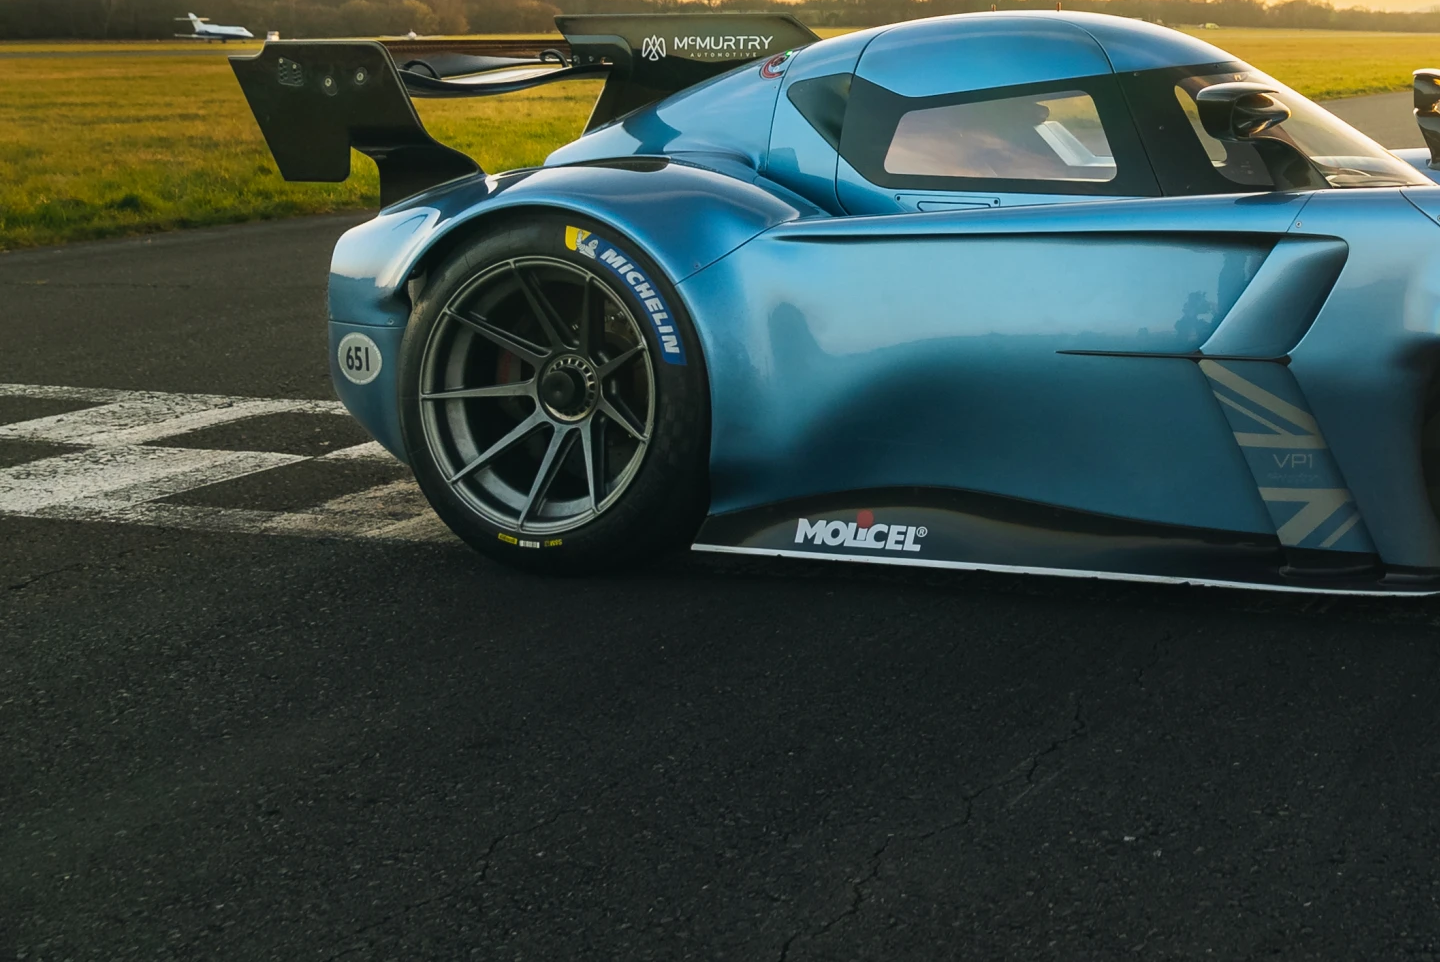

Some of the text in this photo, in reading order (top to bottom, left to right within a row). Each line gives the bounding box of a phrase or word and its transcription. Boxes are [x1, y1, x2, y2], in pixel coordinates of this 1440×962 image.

[600, 248, 680, 354] MICHELIN
[346, 346, 370, 372] 651
[1272, 454, 1312, 469] VP1
